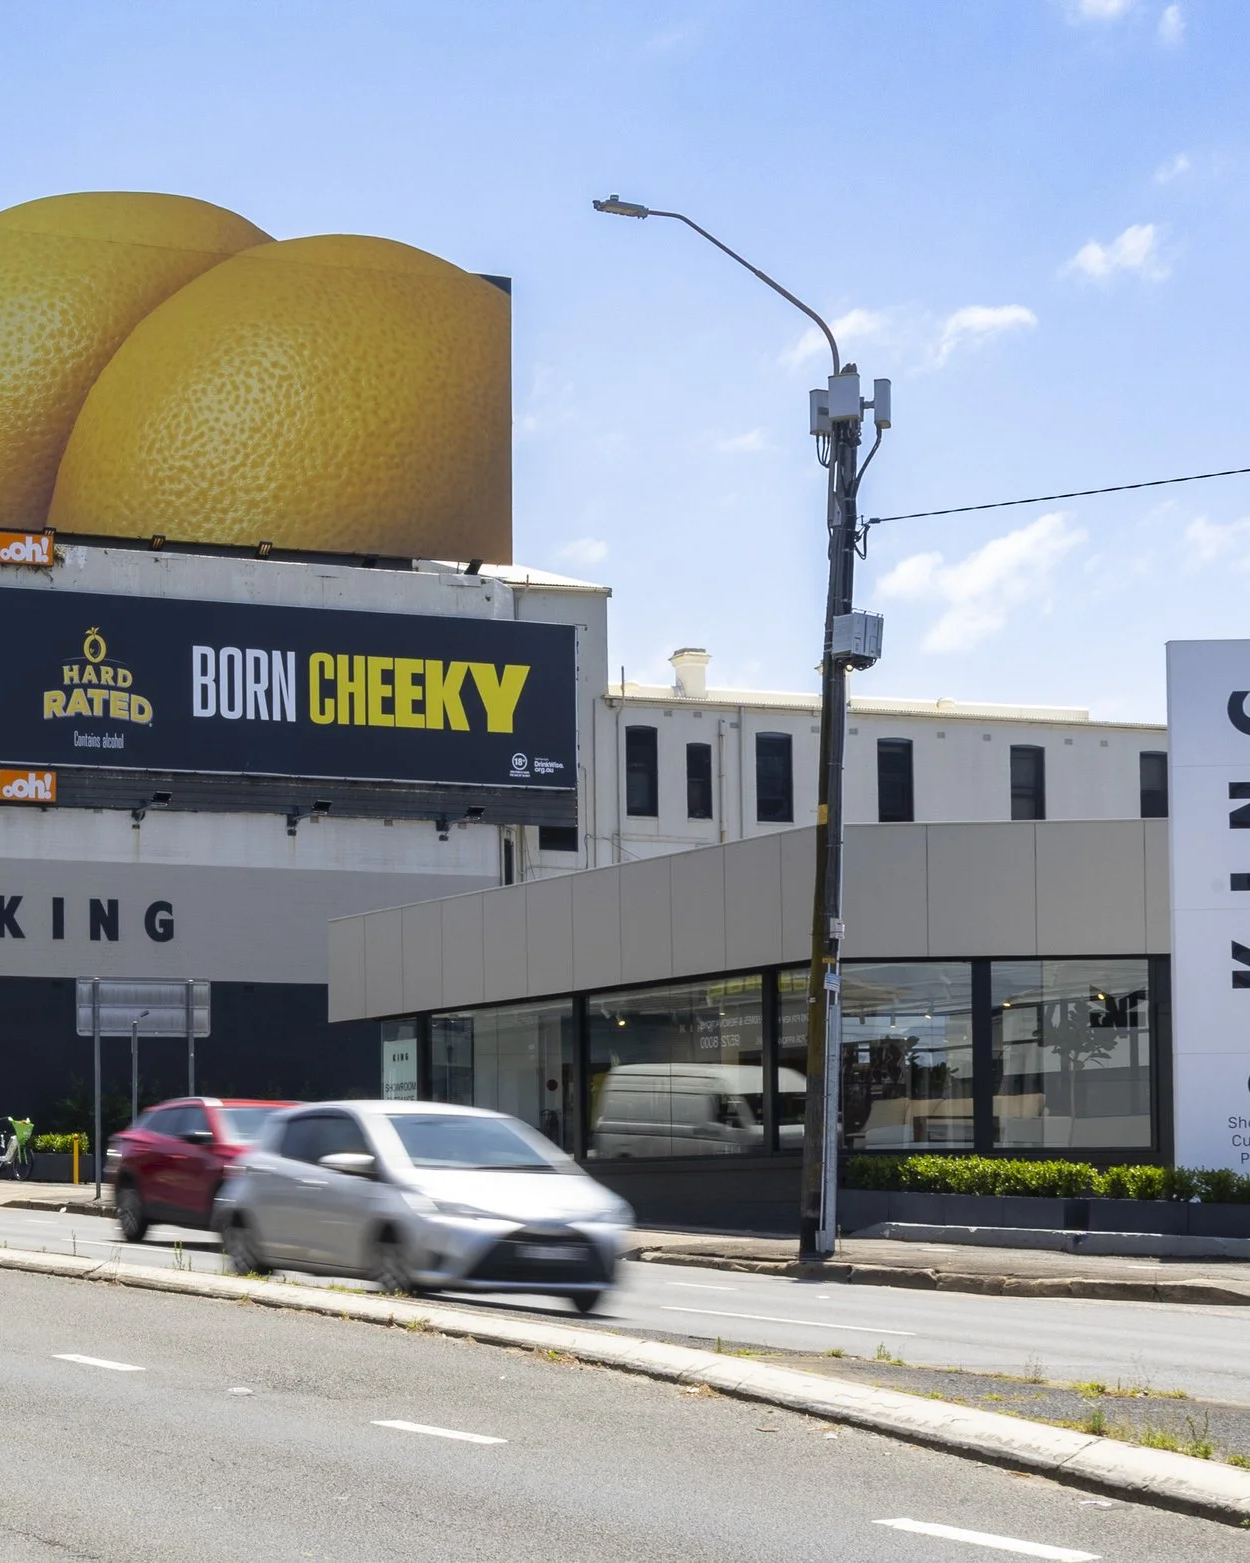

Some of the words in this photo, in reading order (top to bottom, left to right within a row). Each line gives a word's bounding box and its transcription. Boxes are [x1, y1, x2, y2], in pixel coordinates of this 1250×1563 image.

[62, 664, 133, 688] HARD
[192, 645, 297, 722] BORN
[309, 652, 531, 733] CHEEKY
[43, 688, 153, 725] RATED
[74, 730, 101, 748] Contains
[102, 732, 124, 749] alcohol
[1228, 1116, 1250, 1129] Sh
